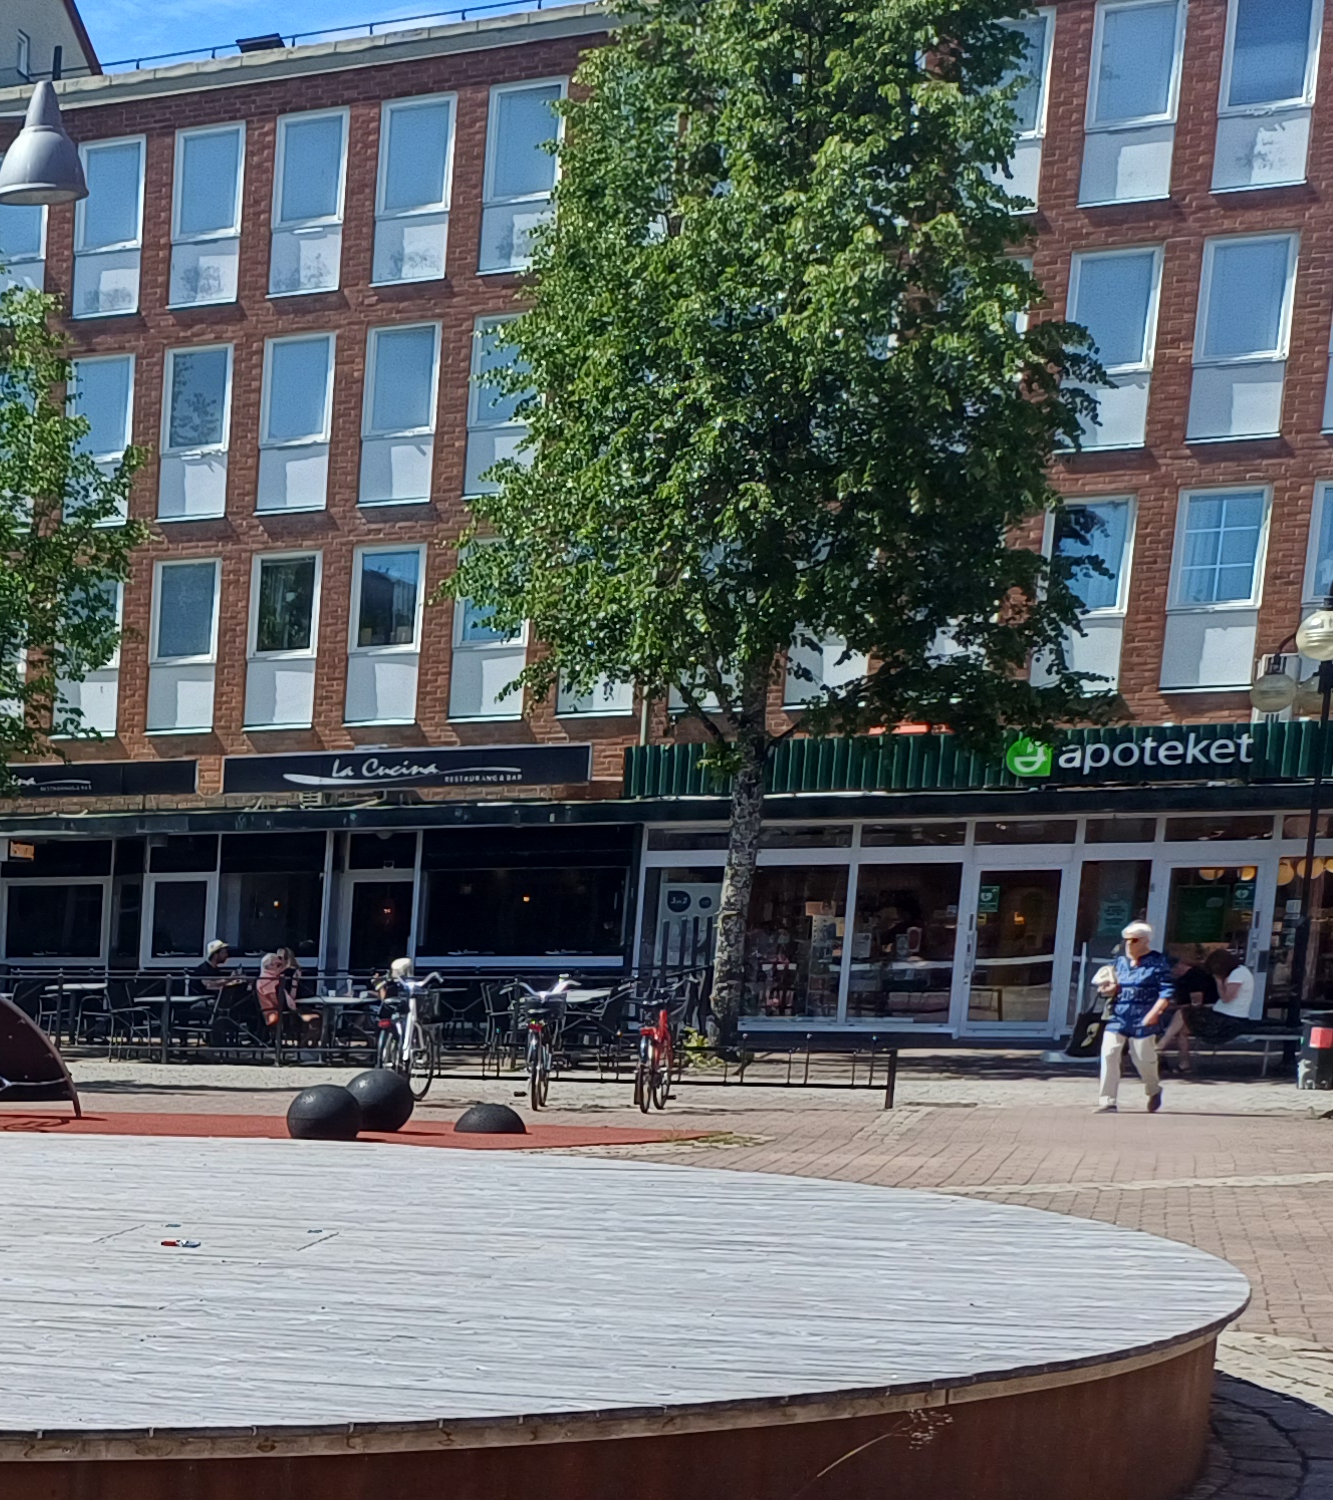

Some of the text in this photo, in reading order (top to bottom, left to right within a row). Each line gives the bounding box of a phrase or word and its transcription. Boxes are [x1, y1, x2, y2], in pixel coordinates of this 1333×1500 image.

[332, 758, 439, 777] La Cucina
[1058, 732, 1254, 775] apoteket
